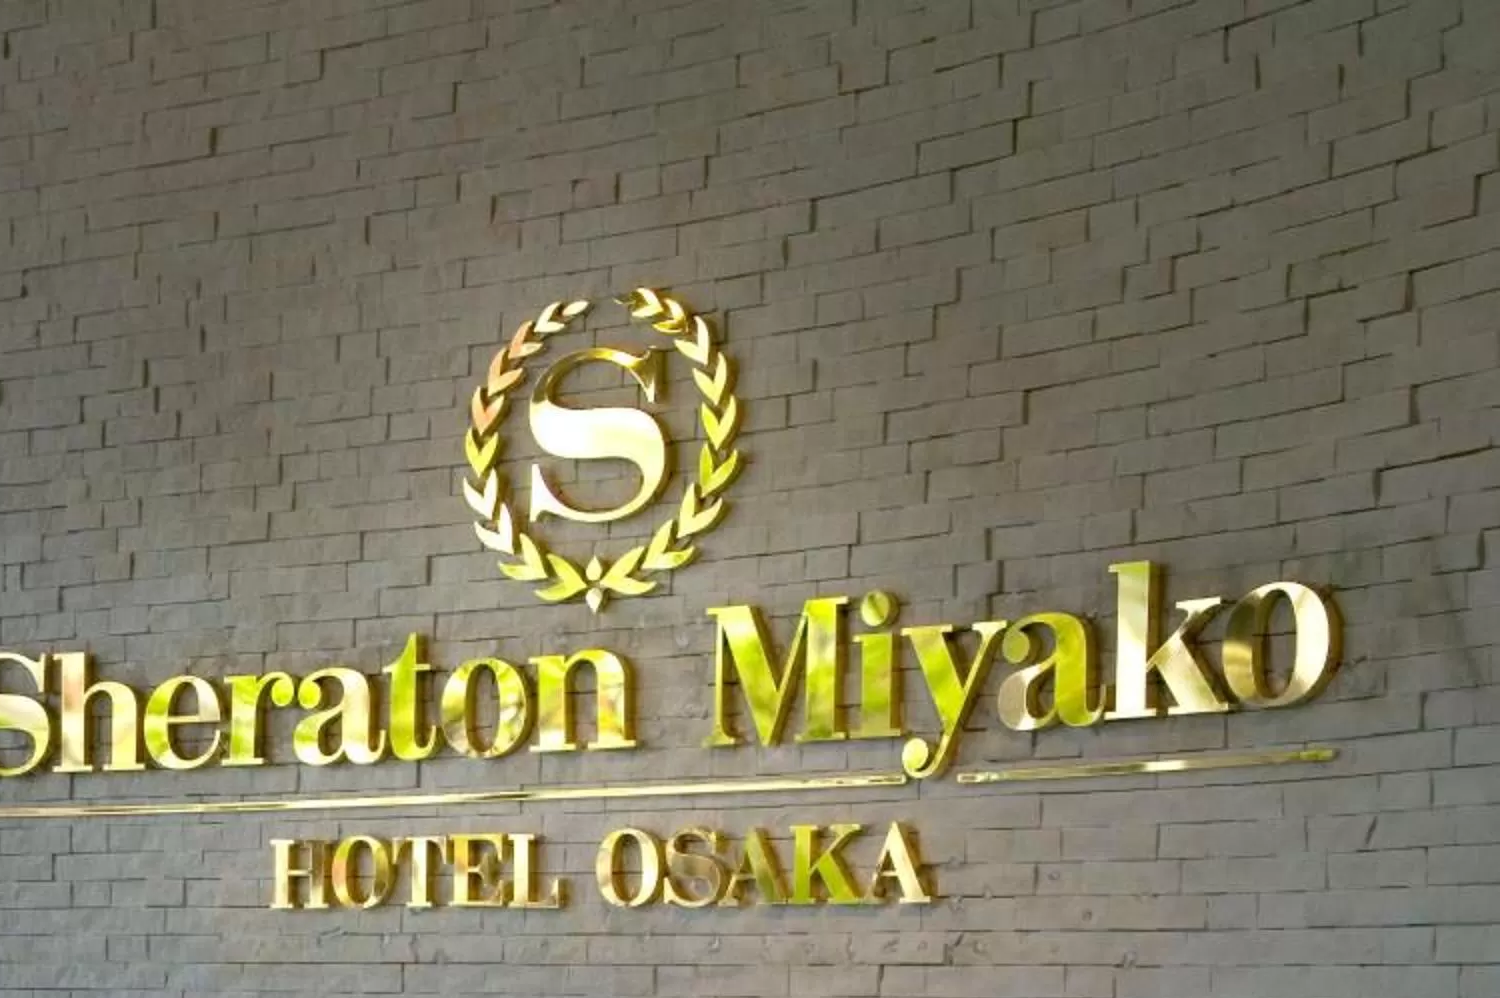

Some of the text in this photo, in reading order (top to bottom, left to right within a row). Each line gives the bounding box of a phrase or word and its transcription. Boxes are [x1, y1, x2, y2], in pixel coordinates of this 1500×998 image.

[703, 560, 1343, 780] Miyako
[269, 822, 933, 910] HOTEL OSAKA
